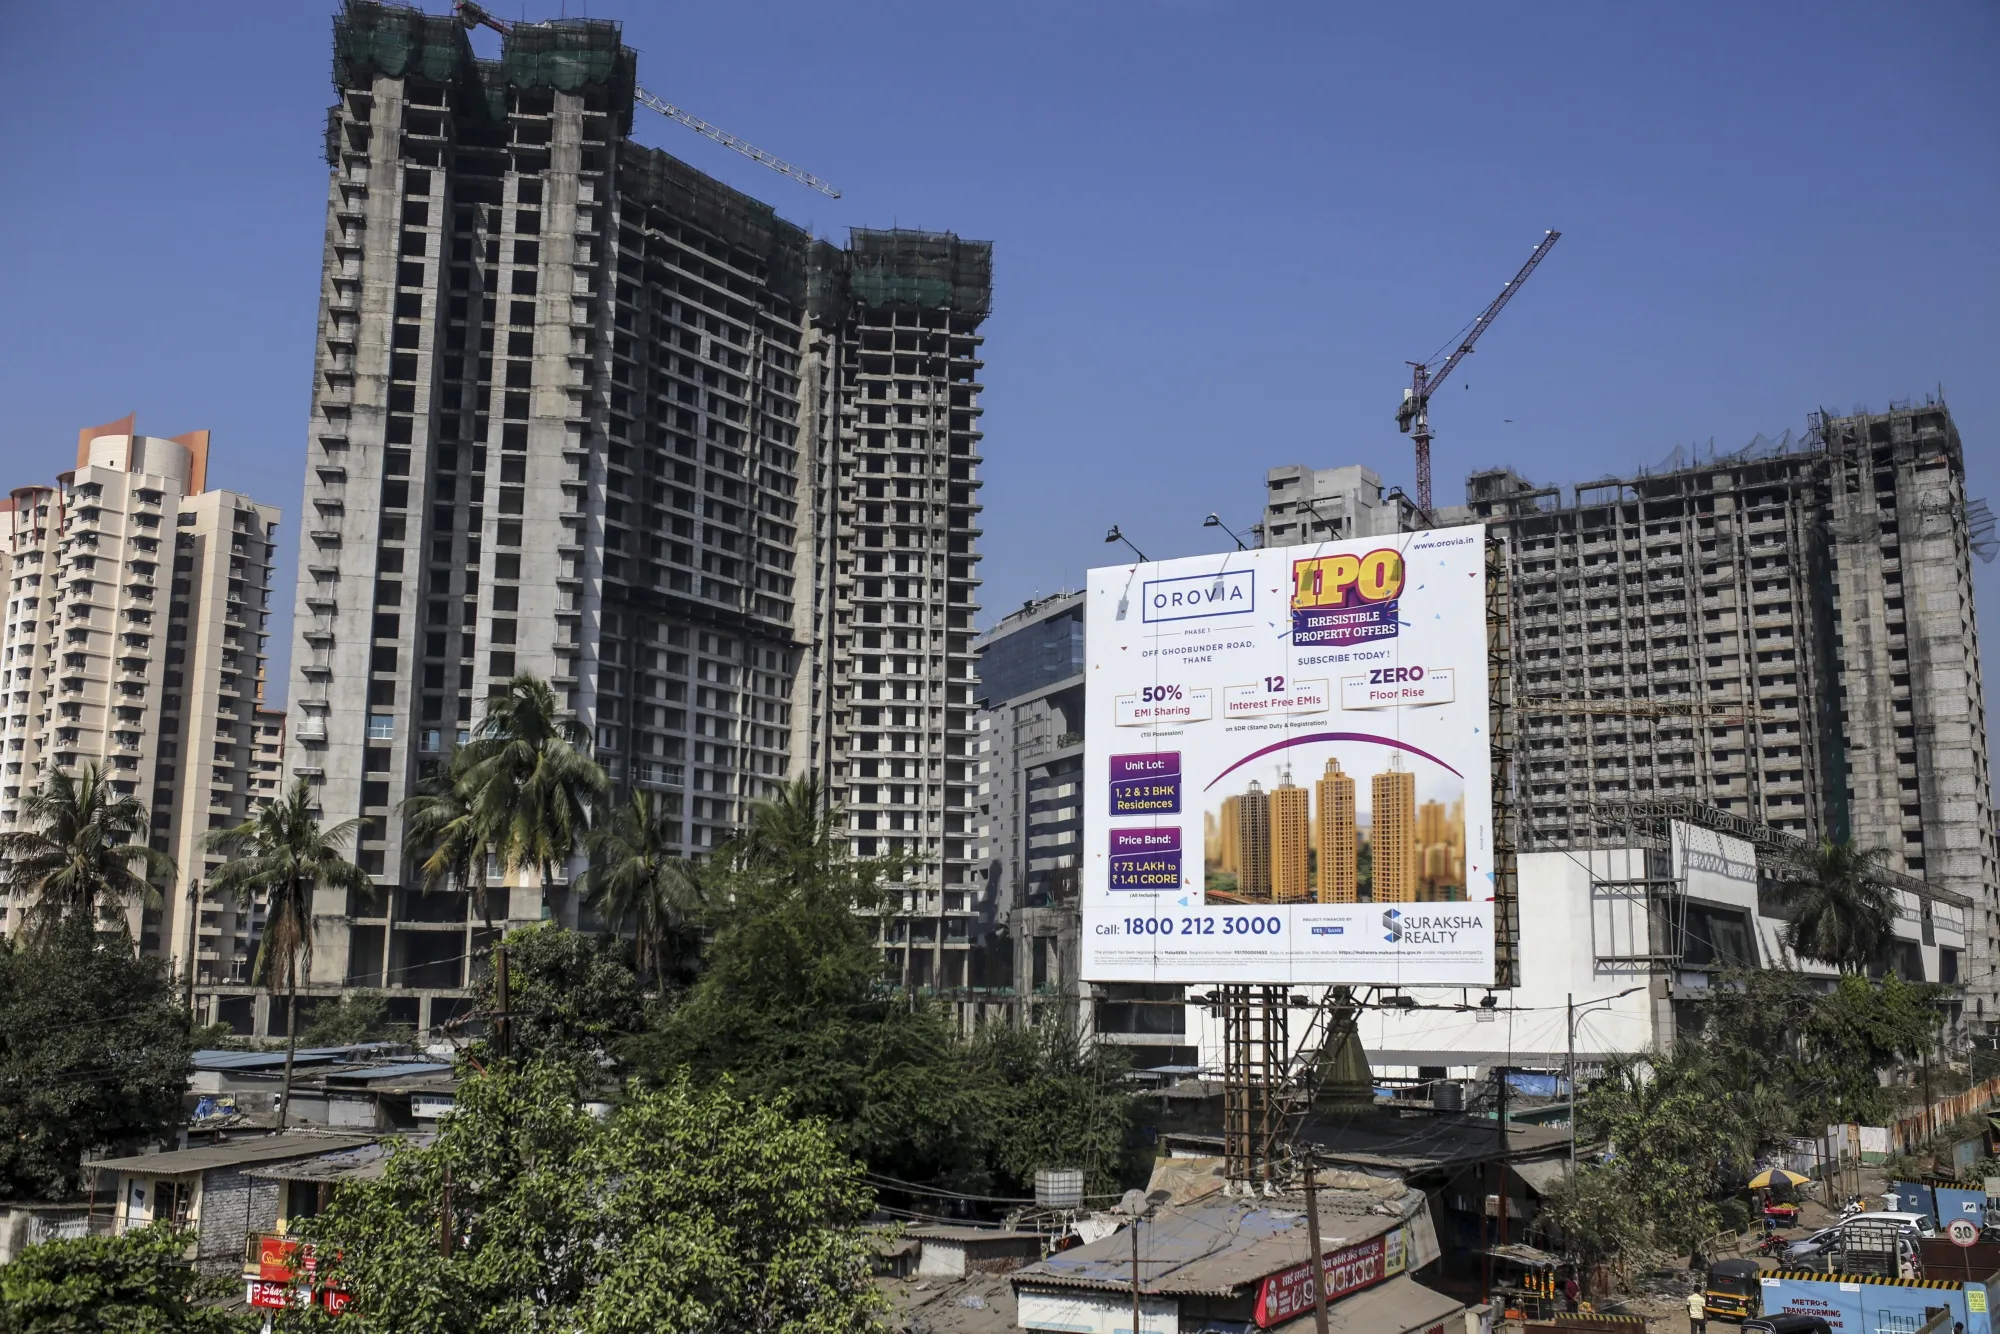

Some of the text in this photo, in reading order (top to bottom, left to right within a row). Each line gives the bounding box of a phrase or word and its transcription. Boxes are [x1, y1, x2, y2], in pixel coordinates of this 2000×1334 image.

[1413, 537, 1474, 550] www.orovia.in
[1292, 549, 1405, 608] IPO
[1154, 586, 1242, 608] OROVIA
[1308, 612, 1380, 628] IRRESISTIBLE
[1295, 624, 1396, 642] PROPERTY OFFERS
[1162, 644, 1223, 656] GHODBUNDER
[1227, 641, 1255, 649] ROAD,
[1183, 656, 1212, 664] THANE
[1298, 654, 1350, 665] SUBSCRIBE
[1370, 666, 1424, 684] ZERO
[1265, 676, 1284, 692] 12
[1142, 684, 1182, 702] 50%
[1370, 688, 1425, 700] Floor Rise
[1230, 696, 1321, 711] Interest Free EMIs
[1134, 706, 1190, 717] EMI Sharing
[1269, 722, 1282, 730] Duty
[1290, 720, 1328, 728] Registration)
[1125, 761, 1164, 770] Unit Lot:
[1116, 786, 1174, 798] 1, 2 & 3 BHK
[1118, 800, 1173, 810] Residences
[1119, 835, 1171, 845] Price Band:
[1122, 862, 1134, 871] 73
[1136, 862, 1165, 871] LAKH
[1121, 875, 1138, 884] 1.41
[1141, 874, 1178, 884] CRORE
[1096, 916, 1281, 935] Call: 1800 212 3000
[1404, 916, 1483, 929] SURAKSHA
[1405, 931, 1457, 943] REALTY
[1953, 1226, 1972, 1239] 30
[1792, 1299, 1828, 1307] METRO-4
[1782, 1307, 1841, 1317] TRANSFORMING
